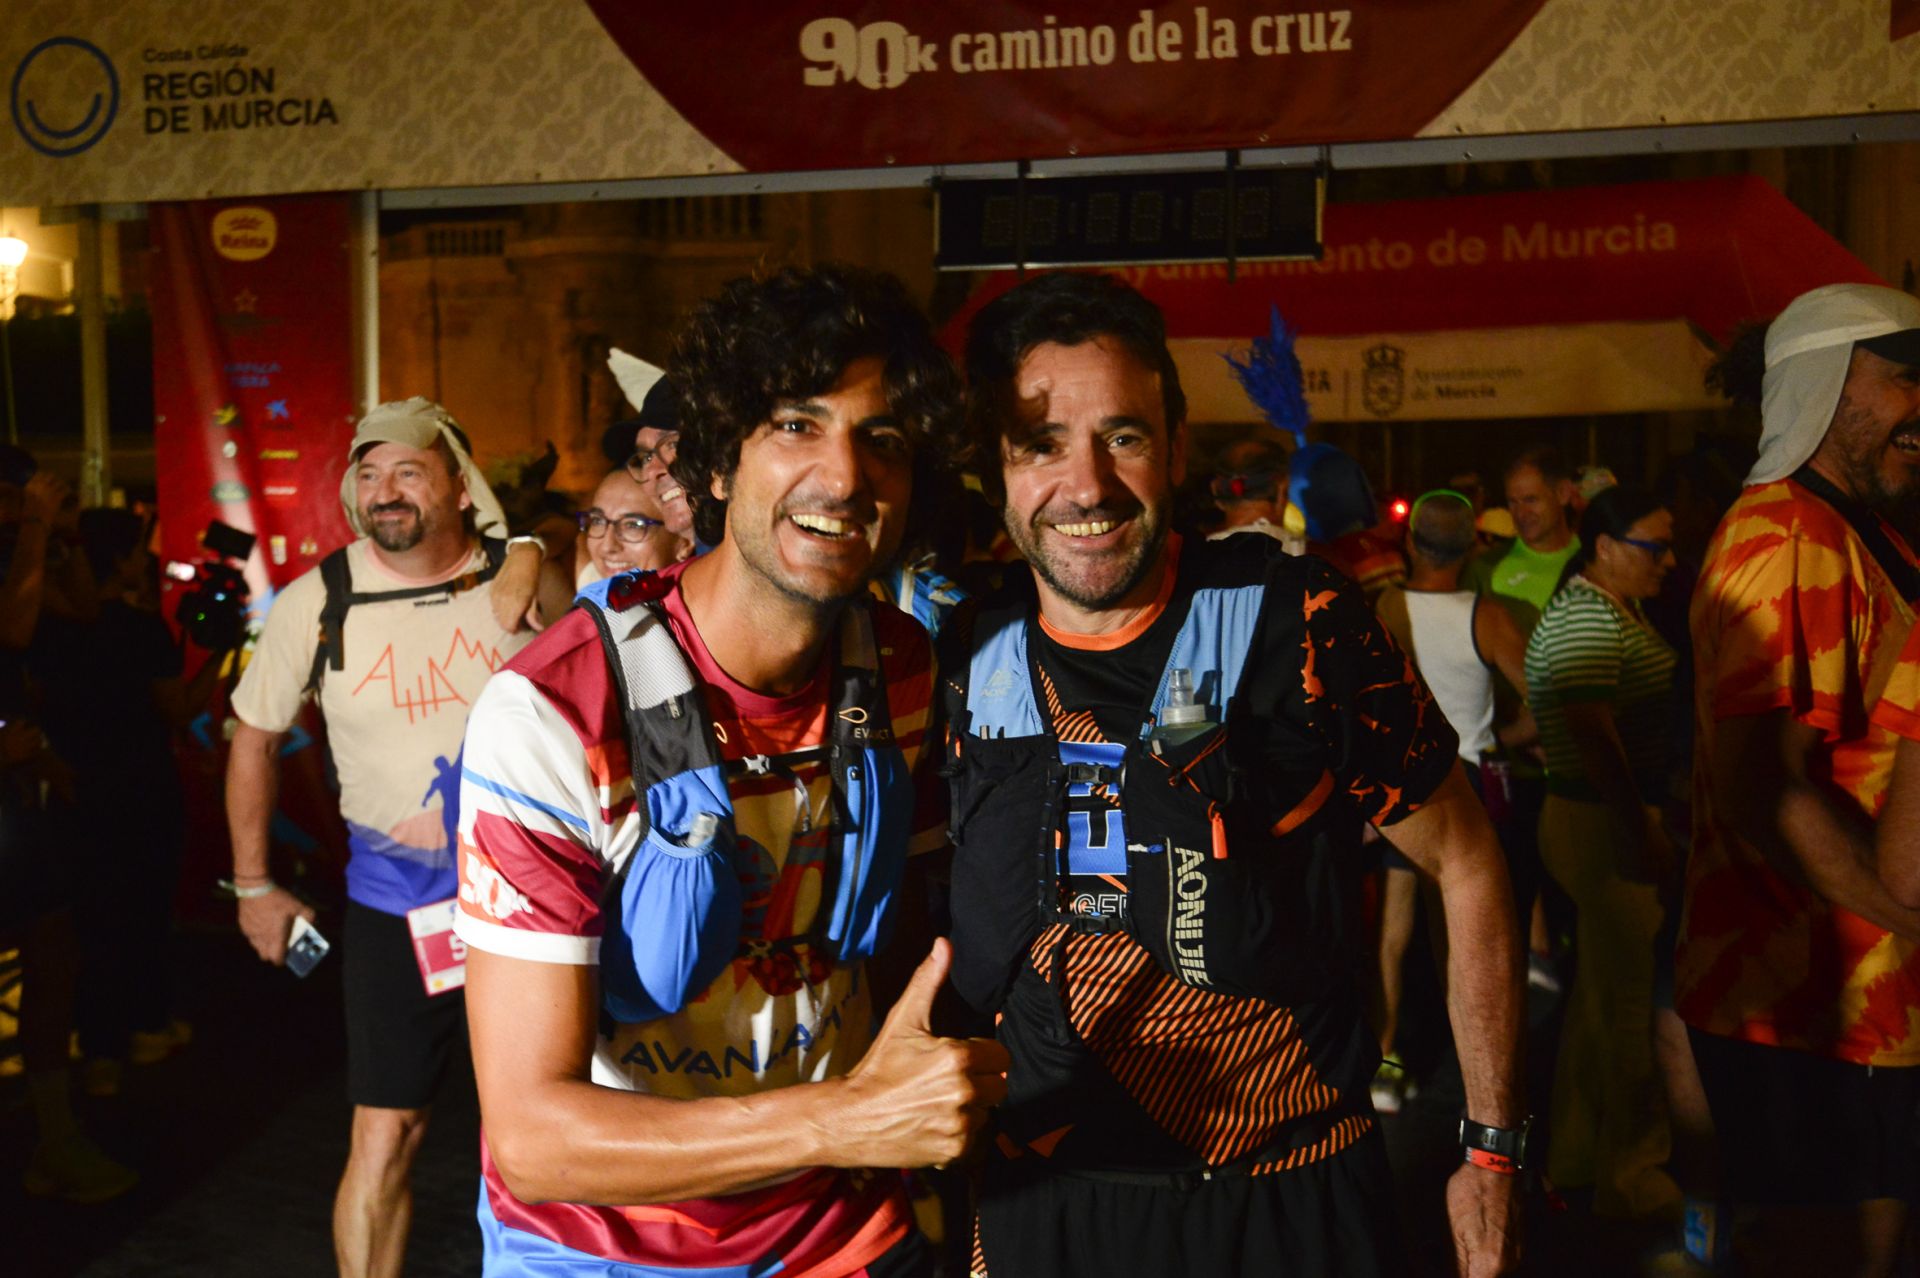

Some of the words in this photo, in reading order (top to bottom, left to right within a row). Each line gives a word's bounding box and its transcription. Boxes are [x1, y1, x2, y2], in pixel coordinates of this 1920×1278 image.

[801, 17, 939, 90] 90k
[949, 15, 1116, 74] camino
[1128, 9, 1182, 63] de
[1195, 7, 1238, 60] la
[1250, 10, 1352, 56] cruz
[143, 62, 275, 101] REGIÓN
[145, 105, 190, 134] DE
[203, 97, 339, 132] MURCIA
[1427, 226, 1487, 268] de
[1504, 213, 1678, 263] Murcia
